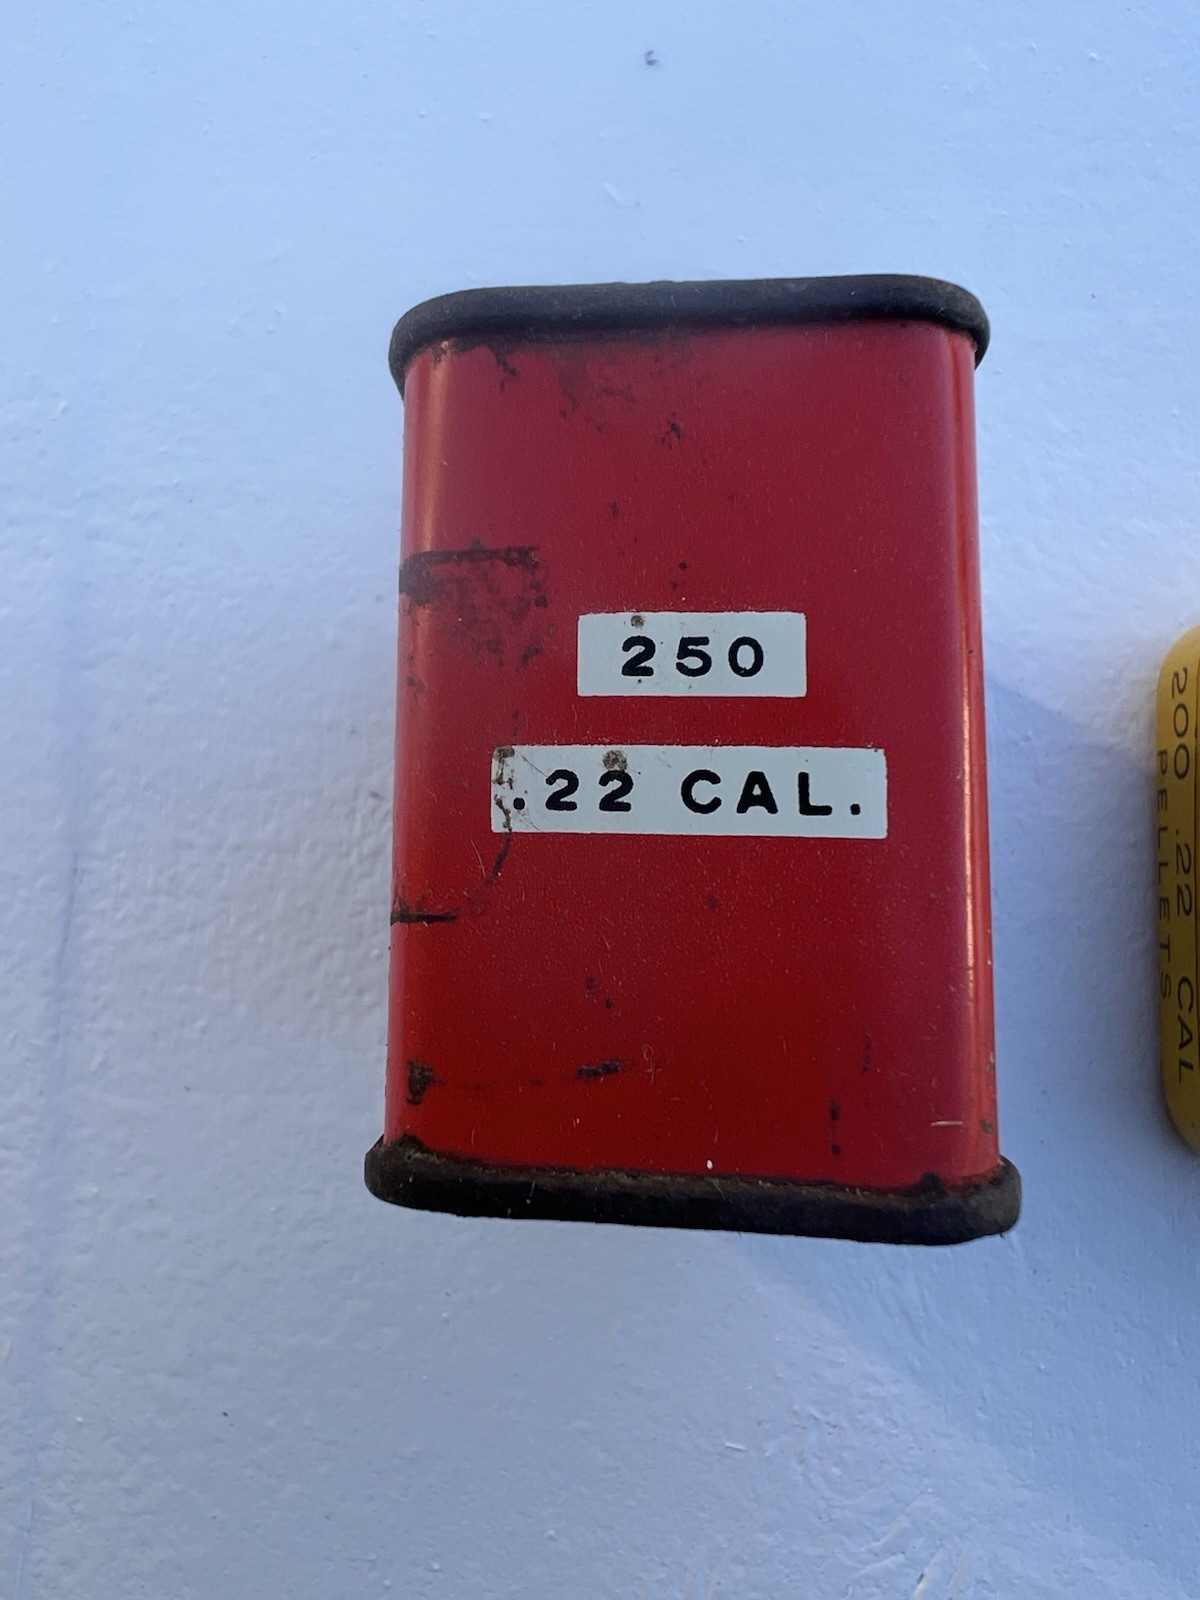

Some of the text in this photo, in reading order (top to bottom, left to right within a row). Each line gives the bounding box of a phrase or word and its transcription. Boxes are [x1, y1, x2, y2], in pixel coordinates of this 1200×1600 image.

[621, 635, 764, 677] 250
[513, 769, 861, 816] .22 CAL.
[1157, 750, 1171, 998] PELLETS
[1172, 667, 1194, 1083] 200 .22 CAL
